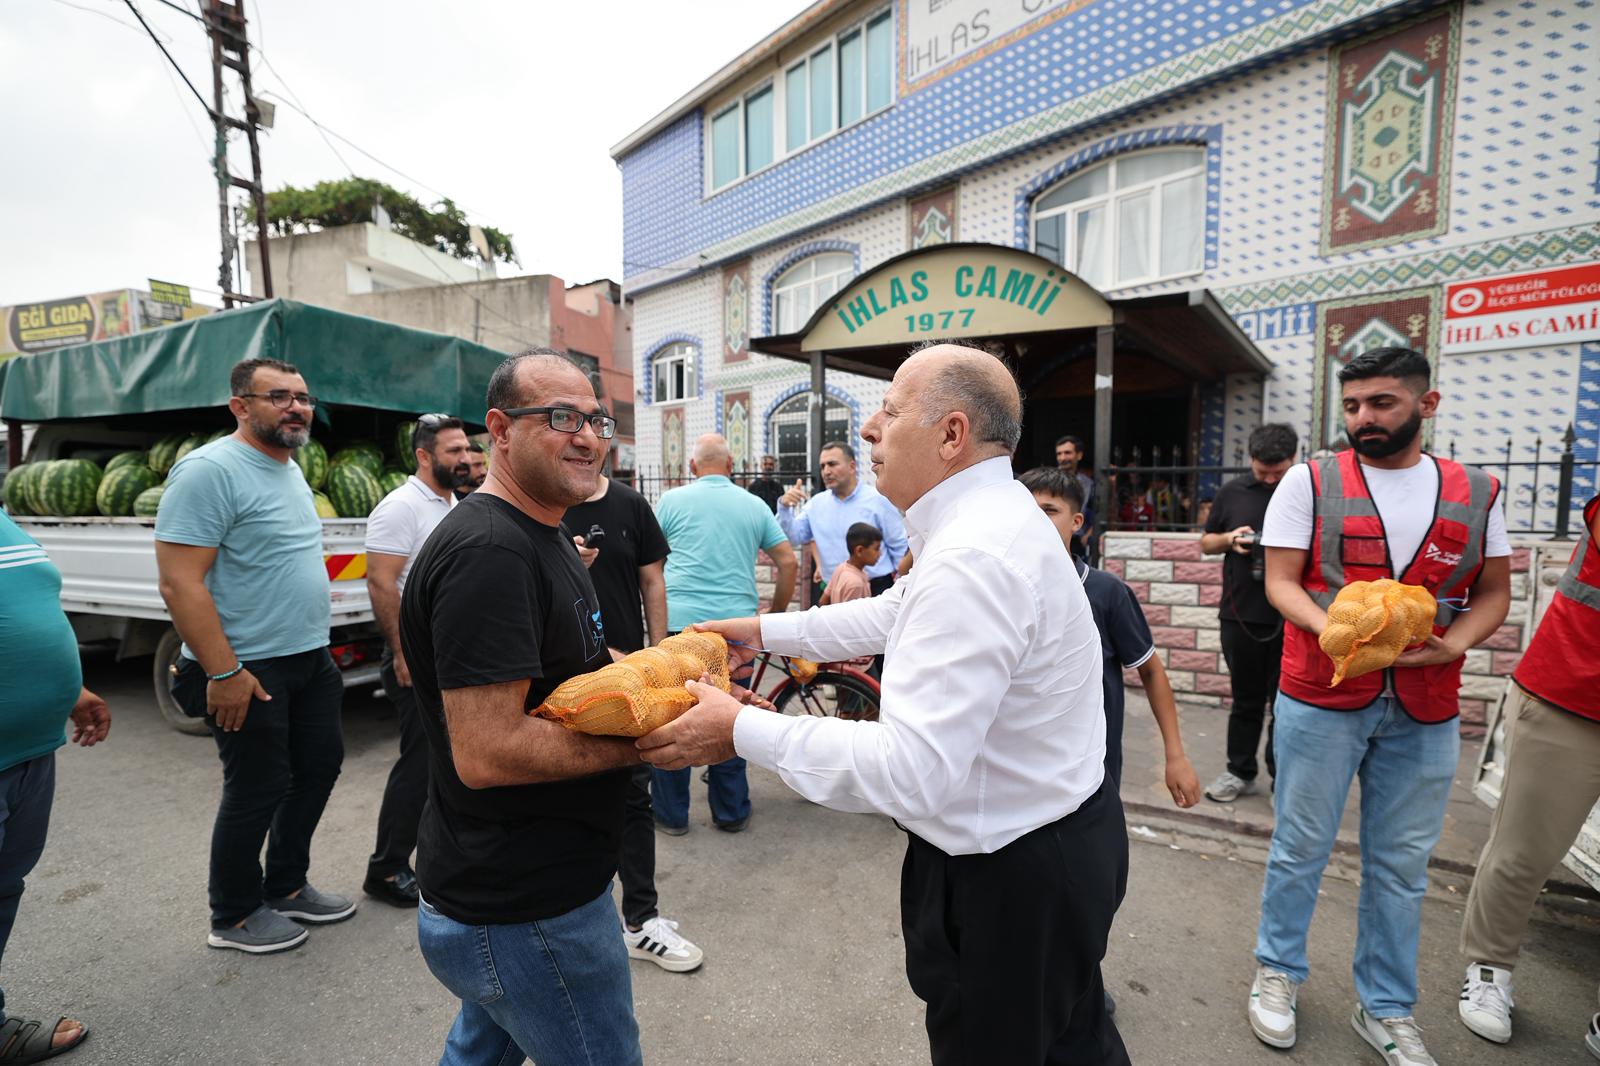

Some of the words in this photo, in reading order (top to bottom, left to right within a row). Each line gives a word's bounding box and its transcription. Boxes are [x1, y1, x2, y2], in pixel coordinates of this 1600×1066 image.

[833, 270, 929, 334] İHLAS
[955, 264, 1068, 316] CAMİİ
[1519, 281, 1600, 303] MÜFTÜLÜĞ
[50, 302, 93, 325] GIDA
[905, 308, 976, 333] 1977
[1446, 320, 1521, 345] İHLAS
